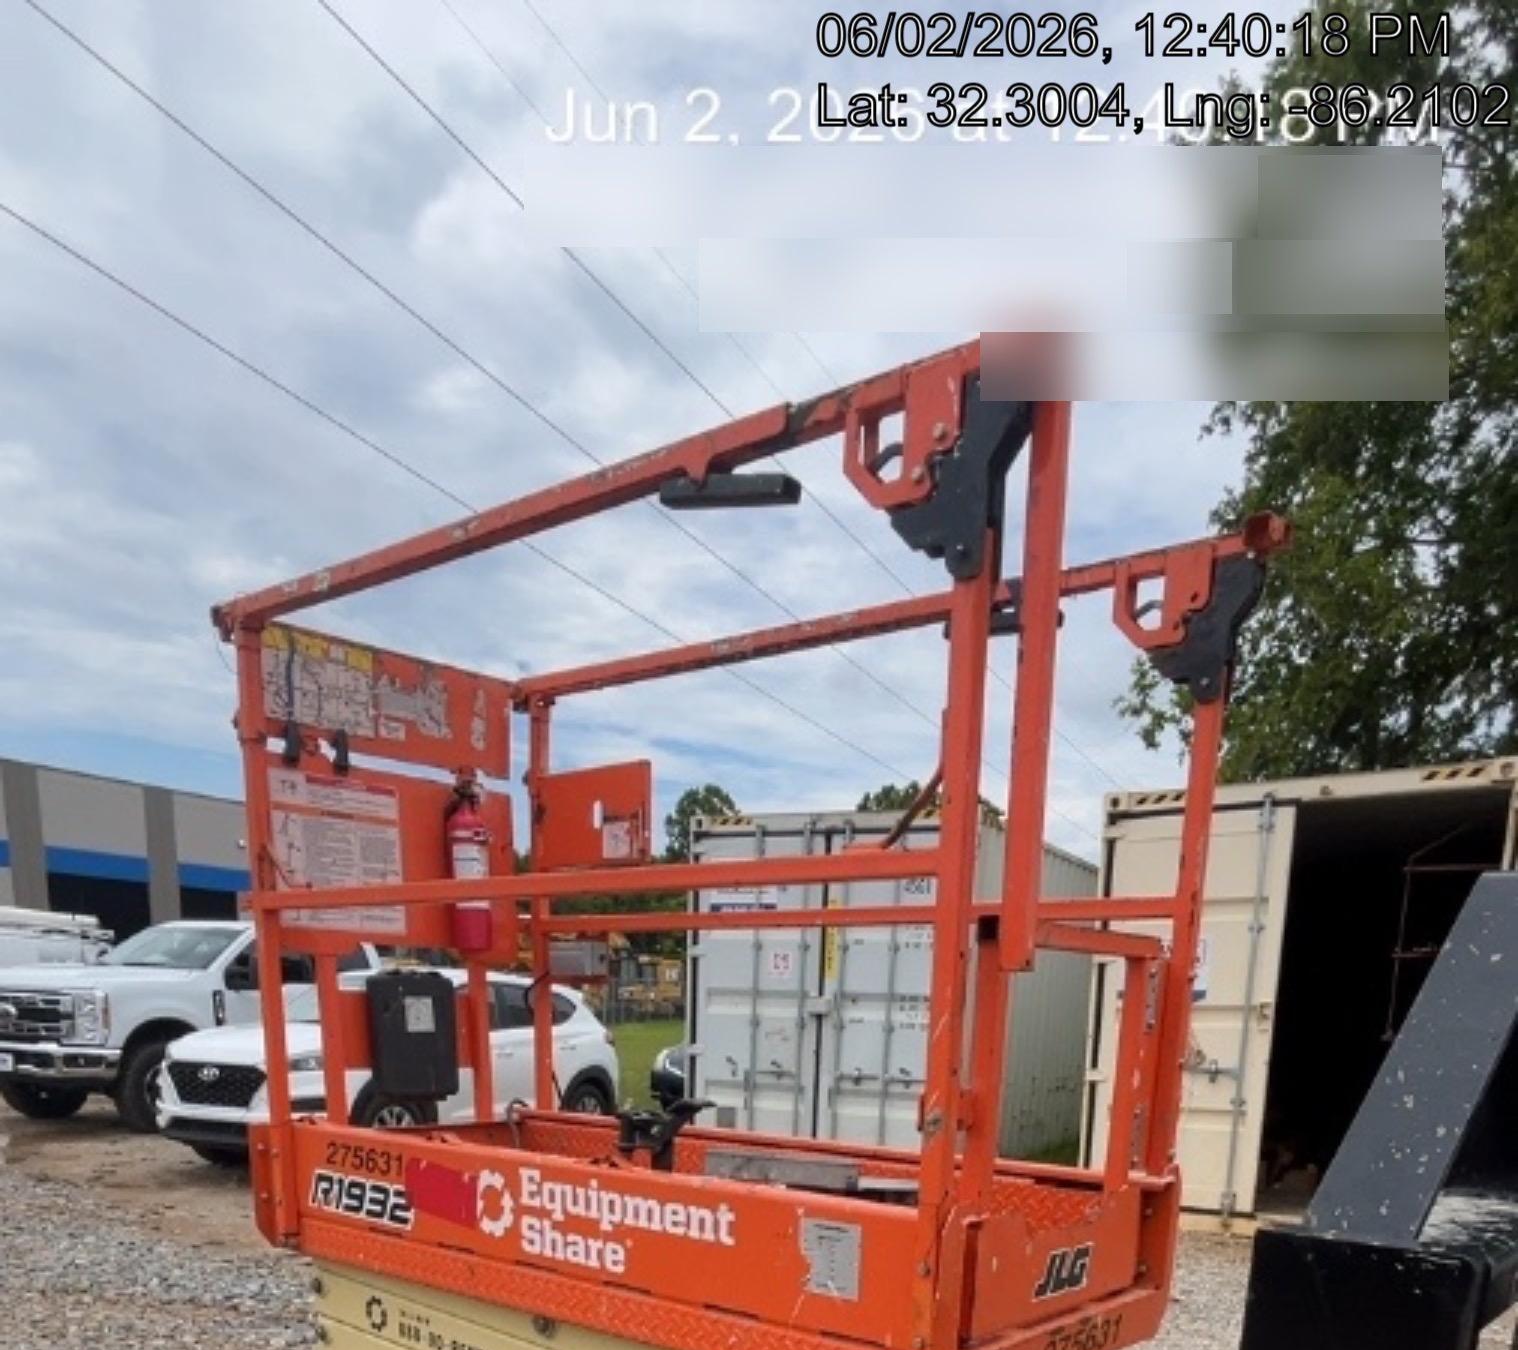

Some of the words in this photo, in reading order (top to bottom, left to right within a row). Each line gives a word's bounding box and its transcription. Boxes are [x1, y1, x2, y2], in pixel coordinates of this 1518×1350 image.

[326, 1141, 404, 1177] 275631
[311, 1171, 413, 1228] R1932
[519, 1167, 737, 1246] Equipment
[521, 1214, 626, 1274] Share
[1033, 1245, 1092, 1300] JLG
